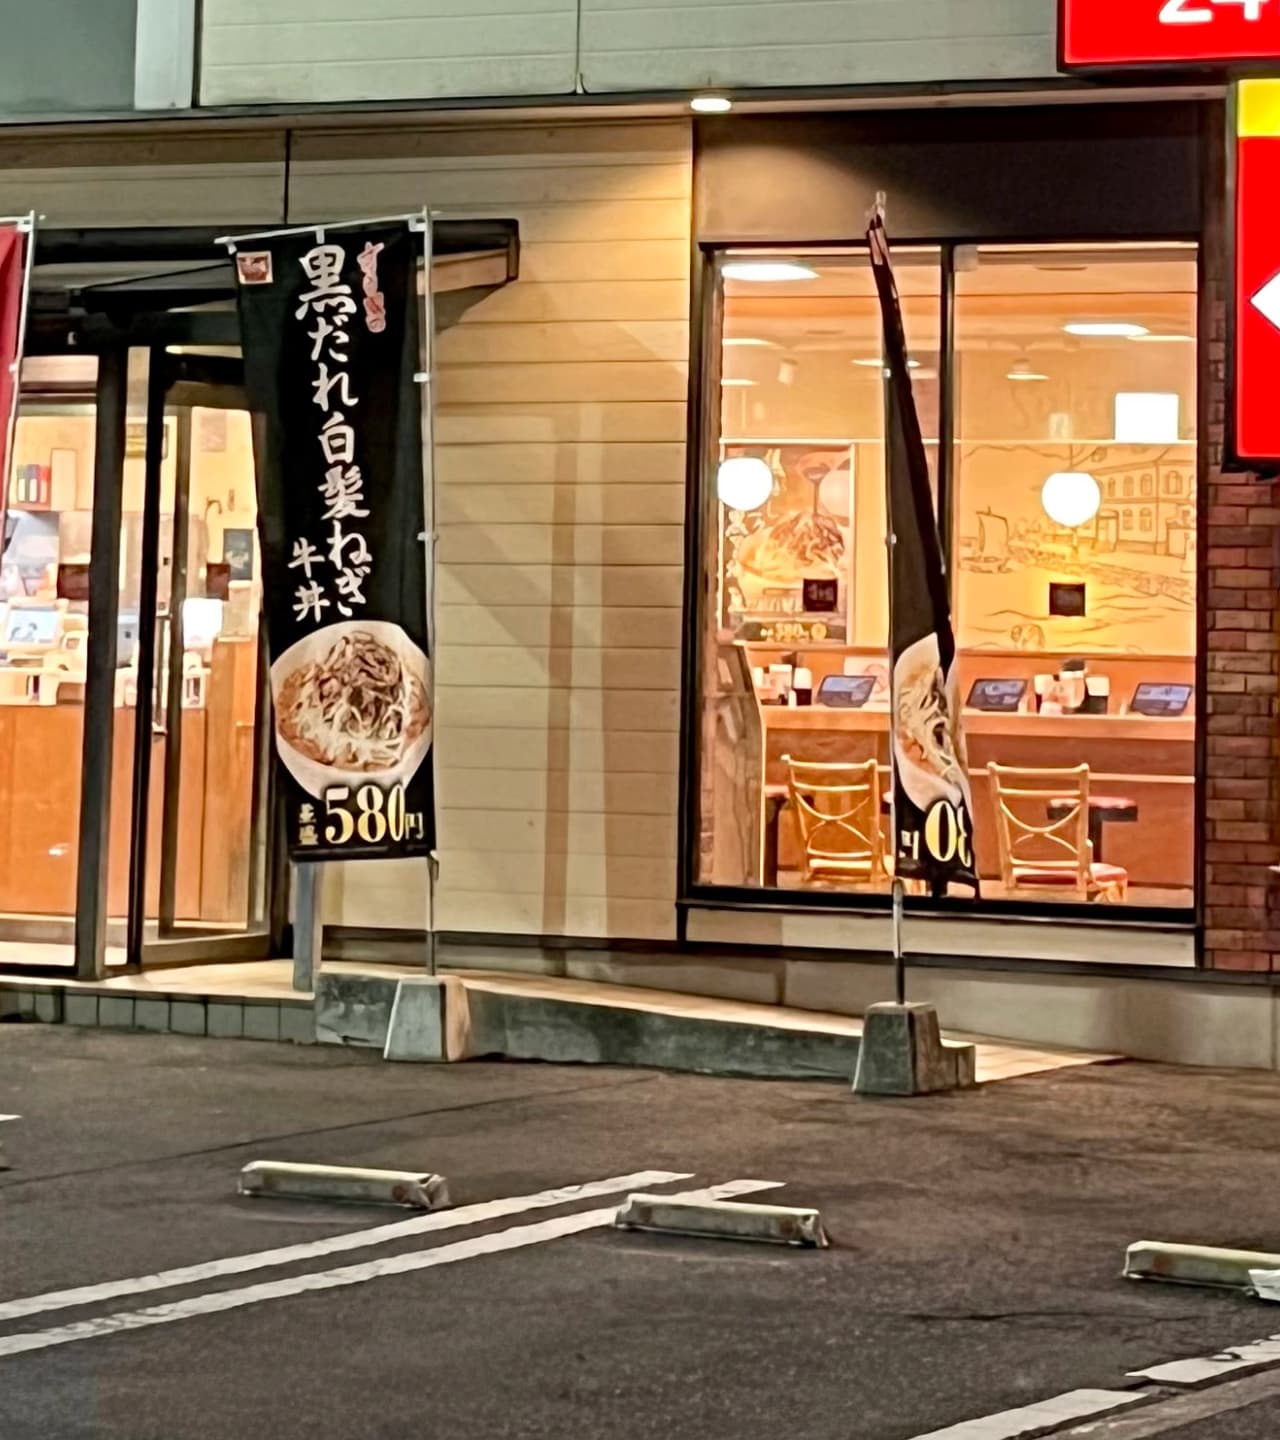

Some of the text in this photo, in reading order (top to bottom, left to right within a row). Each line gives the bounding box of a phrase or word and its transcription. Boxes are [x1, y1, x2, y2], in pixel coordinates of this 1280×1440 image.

[295, 244, 373, 617] 黒だれ白髪ねぎ
[288, 537, 332, 623] 牛丼
